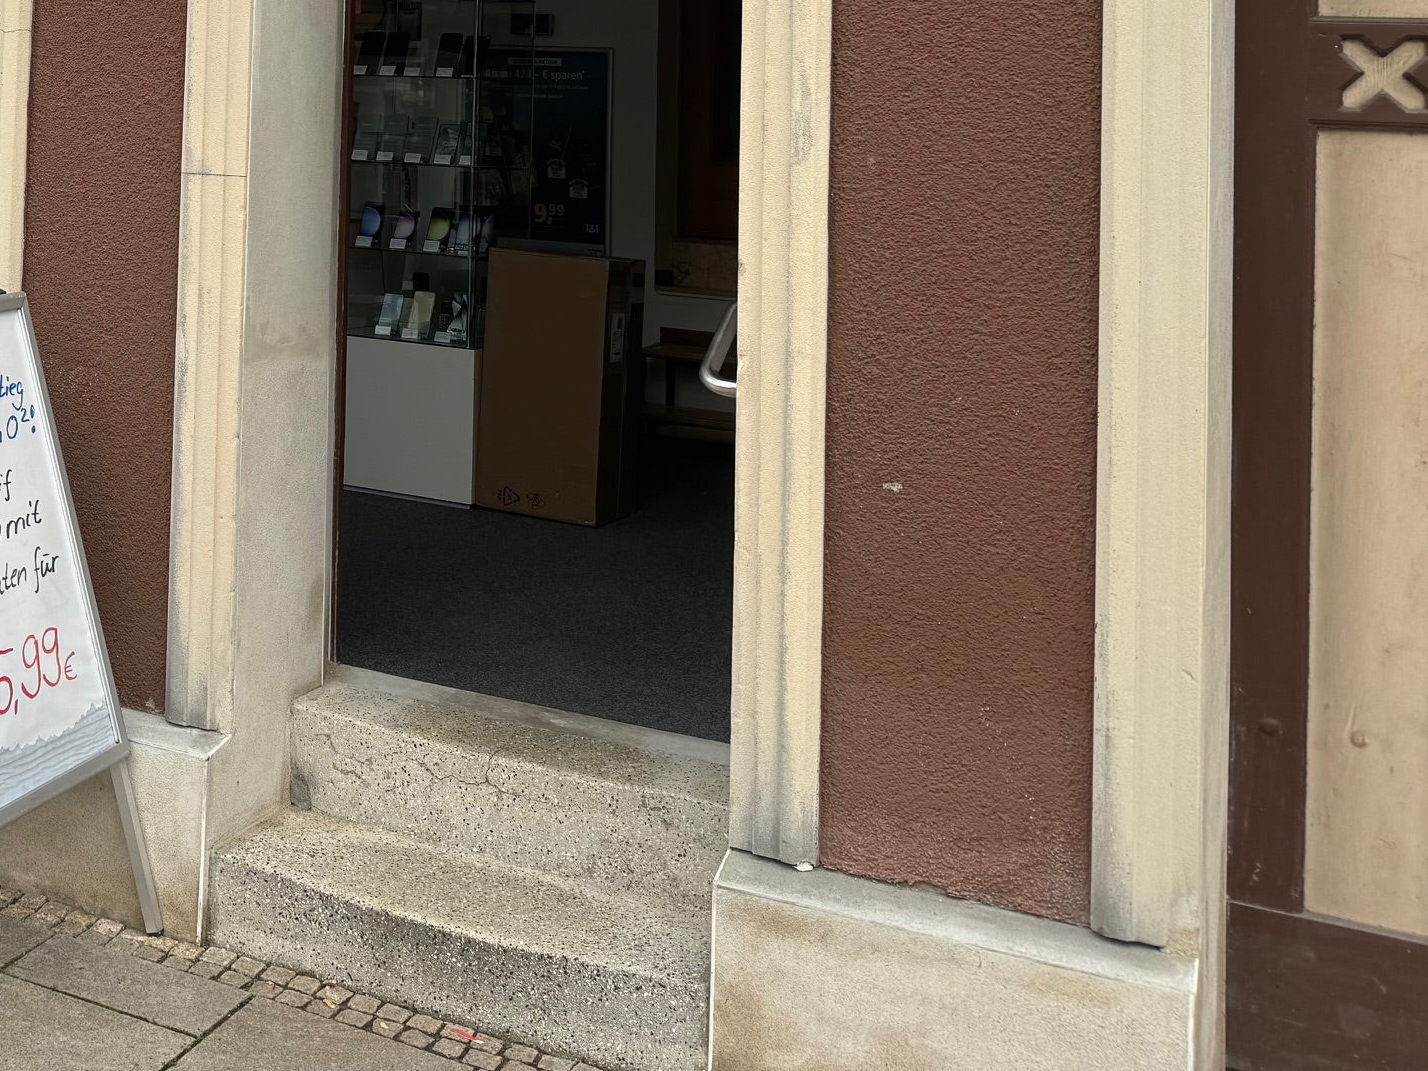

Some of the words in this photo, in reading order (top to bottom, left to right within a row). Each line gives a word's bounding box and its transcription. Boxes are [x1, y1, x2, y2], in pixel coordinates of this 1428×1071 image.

[585, 223, 599, 234] 1&1
[6, 499, 43, 539] mit
[34, 546, 59, 595] für
